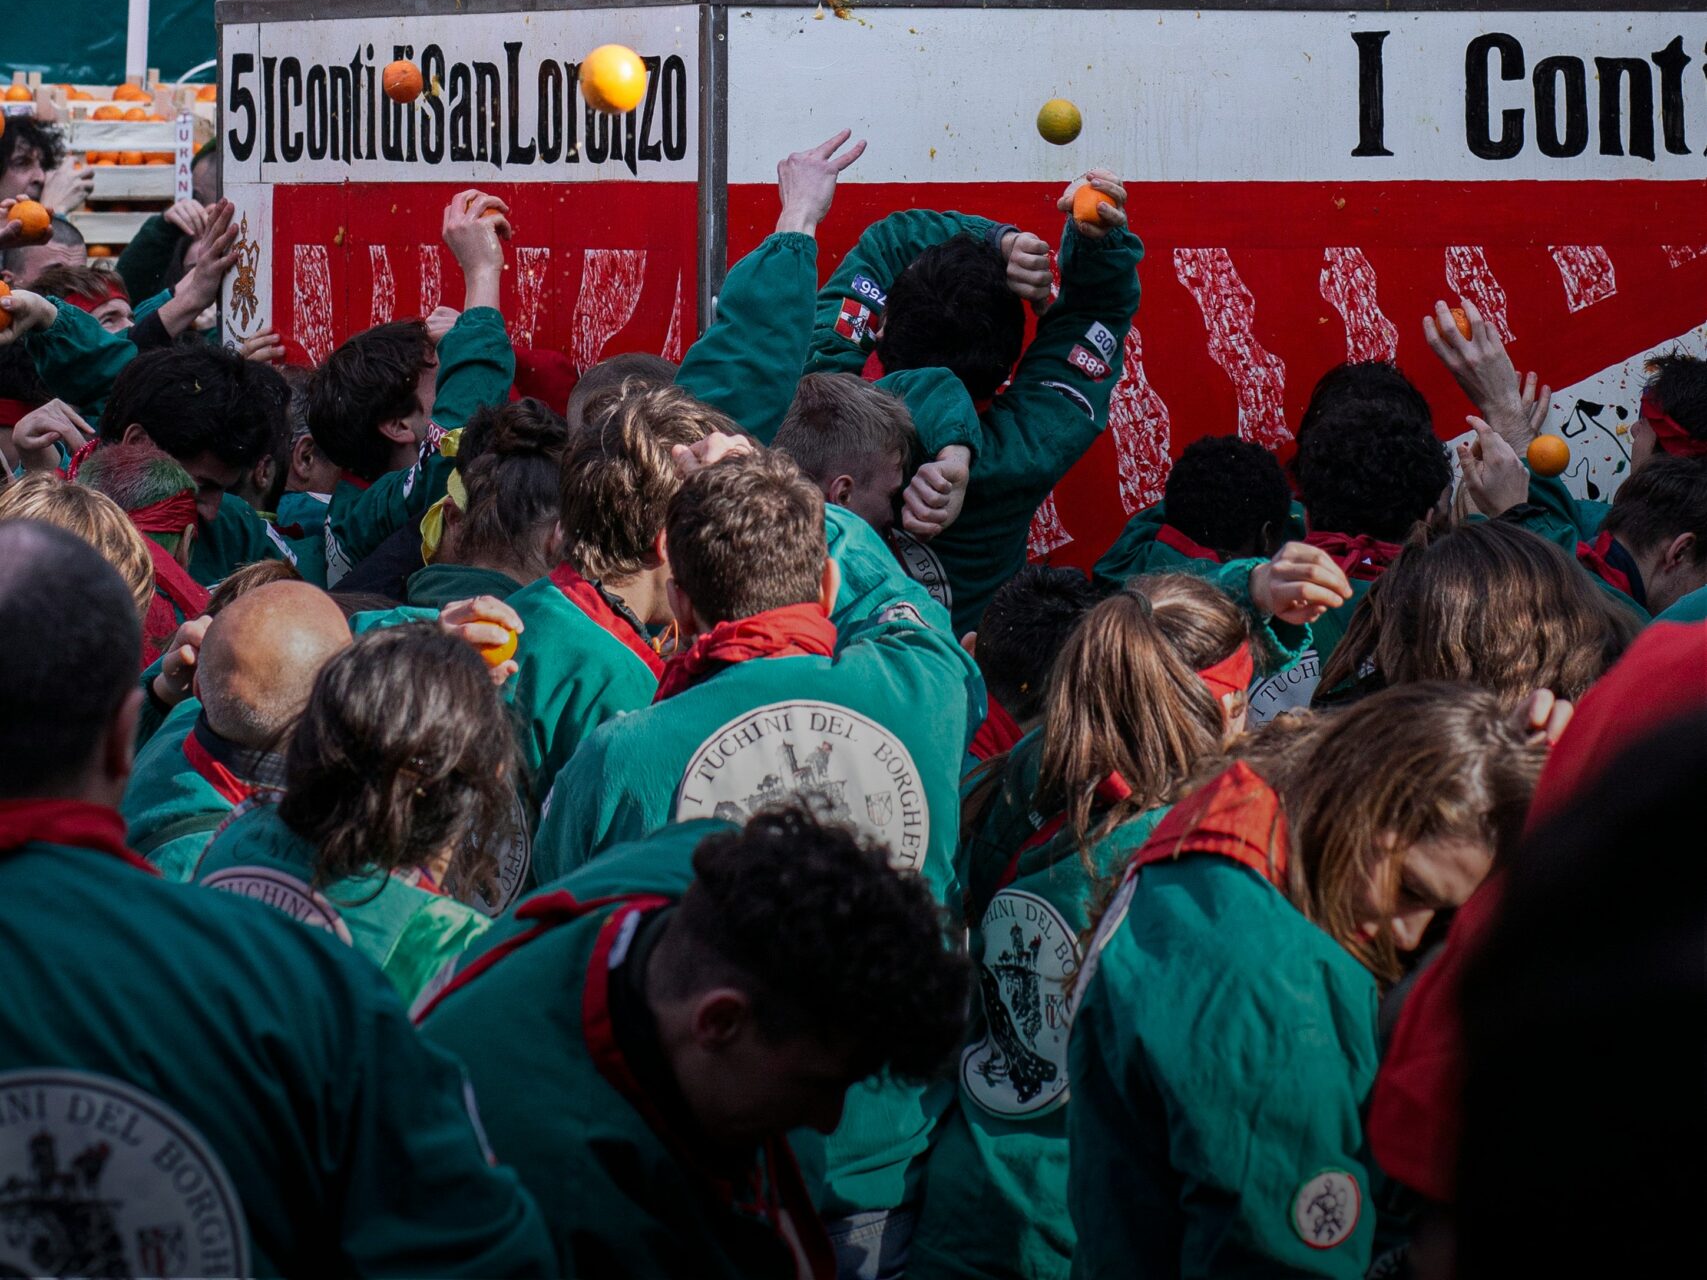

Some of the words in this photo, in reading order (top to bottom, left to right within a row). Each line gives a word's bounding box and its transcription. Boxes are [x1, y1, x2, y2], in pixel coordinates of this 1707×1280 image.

[228, 53, 256, 162] 5
[1351, 29, 1394, 156] I
[1465, 32, 1707, 161] Cont
[178, 111, 190, 202] TUKAN
[860, 281, 887, 306] 756
[1077, 351, 1105, 376] 888
[684, 793, 702, 806] I
[694, 713, 793, 784] TUCHINI
[810, 712, 858, 742] DEL
[873, 742, 922, 867] BORGHET
[1025, 902, 1052, 940] DEL
[67, 1093, 144, 1147] DEL
